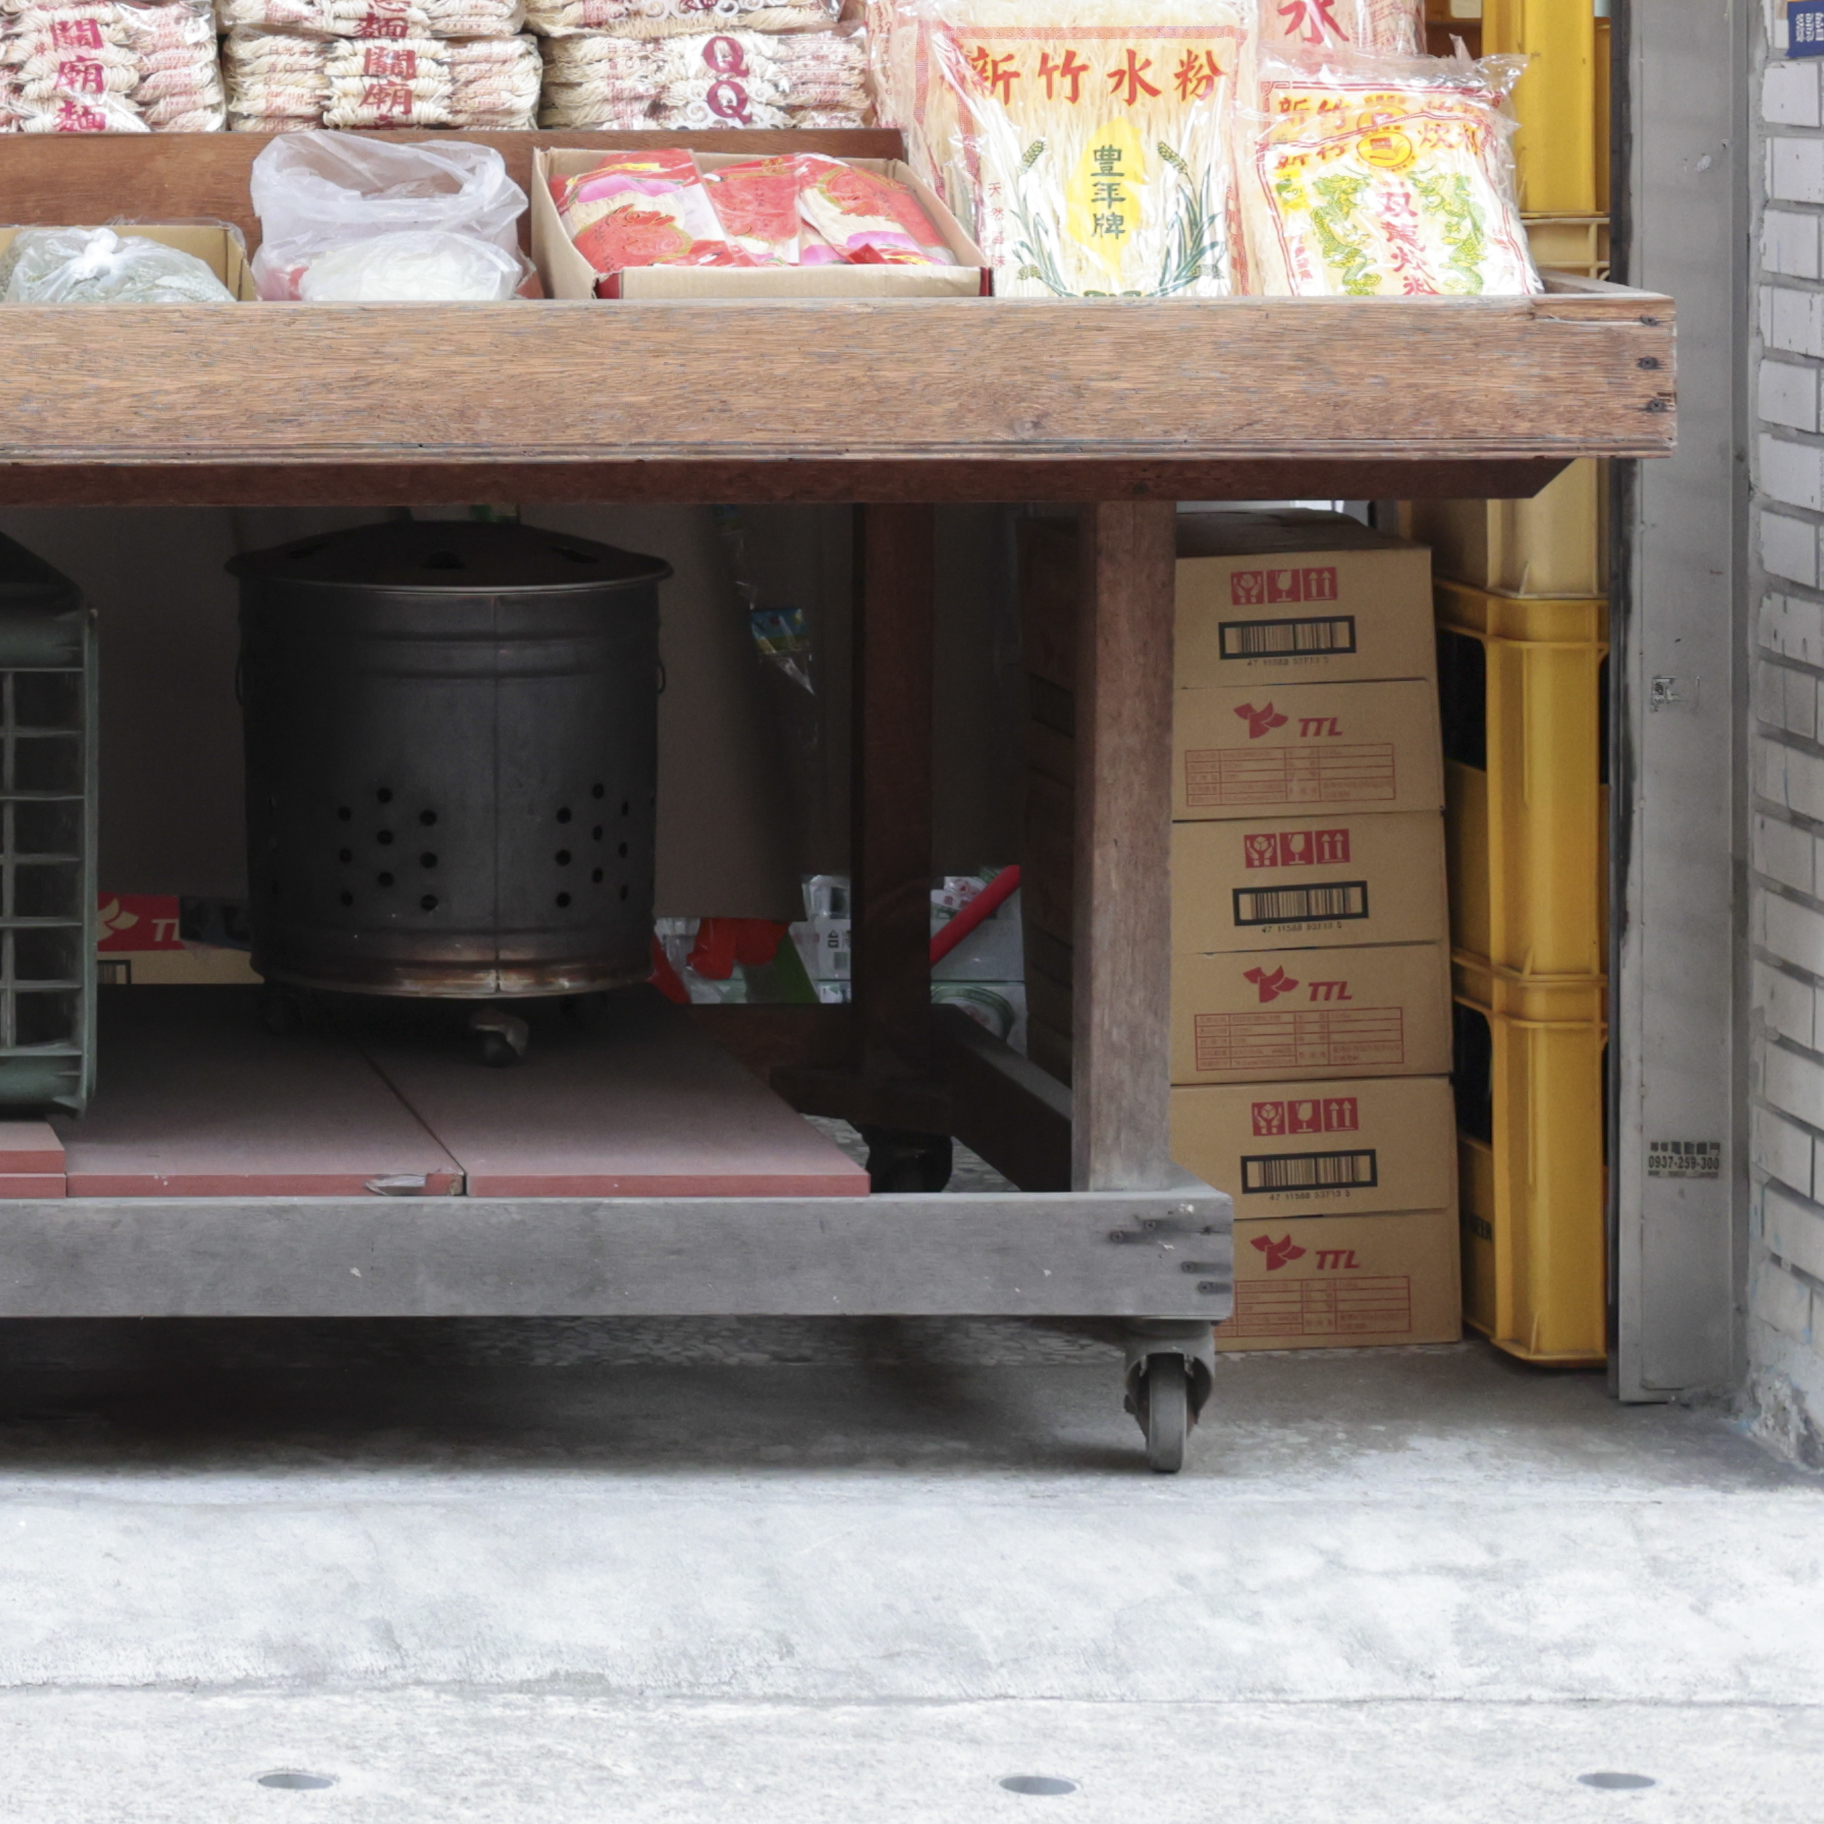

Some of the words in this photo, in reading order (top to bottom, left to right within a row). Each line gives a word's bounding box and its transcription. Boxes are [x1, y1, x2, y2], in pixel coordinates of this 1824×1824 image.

[966, 46, 1229, 108] 新竹水粉
[1297, 716, 1344, 739] TTL
[1308, 978, 1354, 1002] TTL
[1315, 1247, 1362, 1271] TTL
